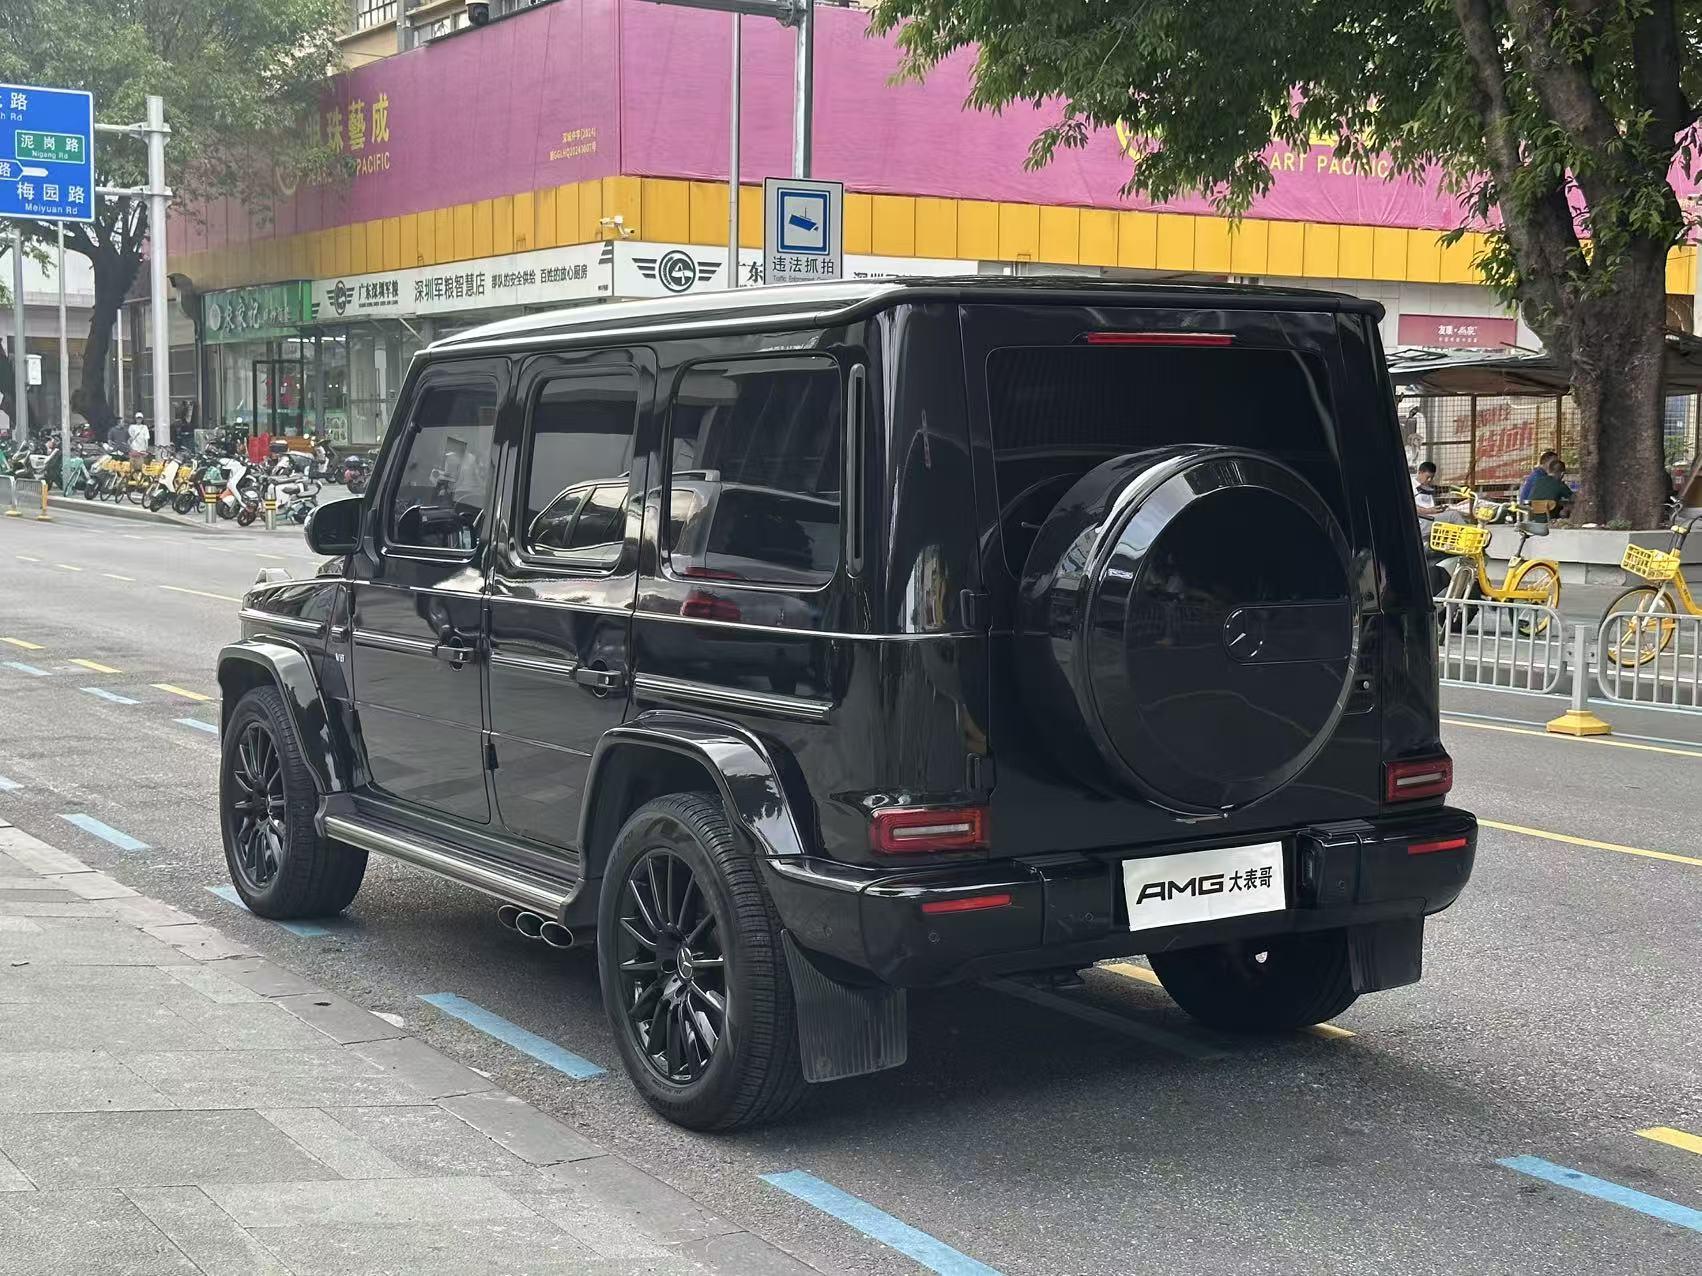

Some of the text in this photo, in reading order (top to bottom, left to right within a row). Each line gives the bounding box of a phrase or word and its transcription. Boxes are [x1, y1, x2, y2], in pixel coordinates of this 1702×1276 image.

[0, 92, 28, 111] 路
[10, 112, 23, 122] Rd
[20, 134, 79, 152] 泥岗路
[31, 150, 56, 160] Nigang
[356, 151, 390, 177] PACIFIC
[16, 182, 85, 204] 梅园路
[25, 203, 78, 214] Meiyuan Rd
[772, 255, 835, 275] 违法抓拍
[358, 263, 588, 304] 广东深圳军粮 深圳军粮智慧店 部队的安全供给 百姓的放心厨房
[1135, 866, 1273, 905] AMG 大表哥
